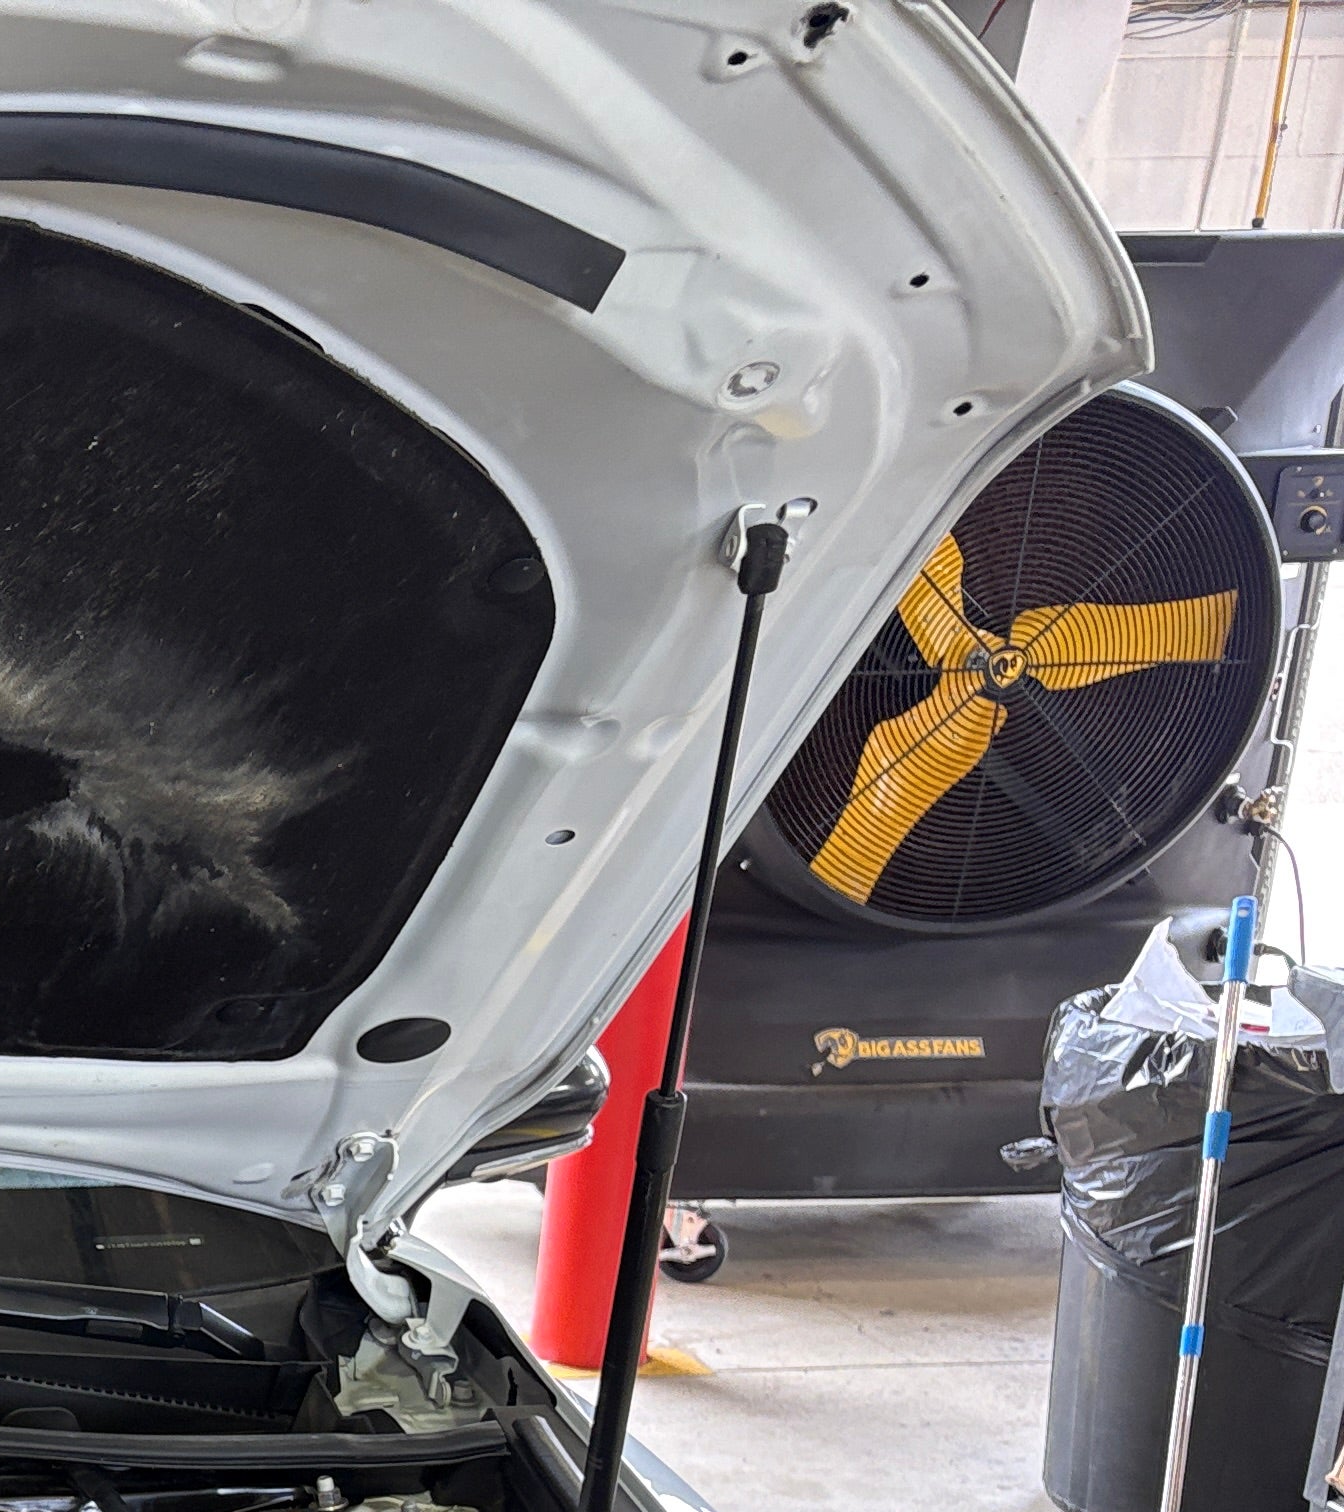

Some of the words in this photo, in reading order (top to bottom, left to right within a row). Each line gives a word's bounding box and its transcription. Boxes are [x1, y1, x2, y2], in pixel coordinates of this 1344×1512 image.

[858, 1040, 891, 1058] BIG
[893, 1039, 930, 1057] ASS
[931, 1039, 980, 1057] FANS
